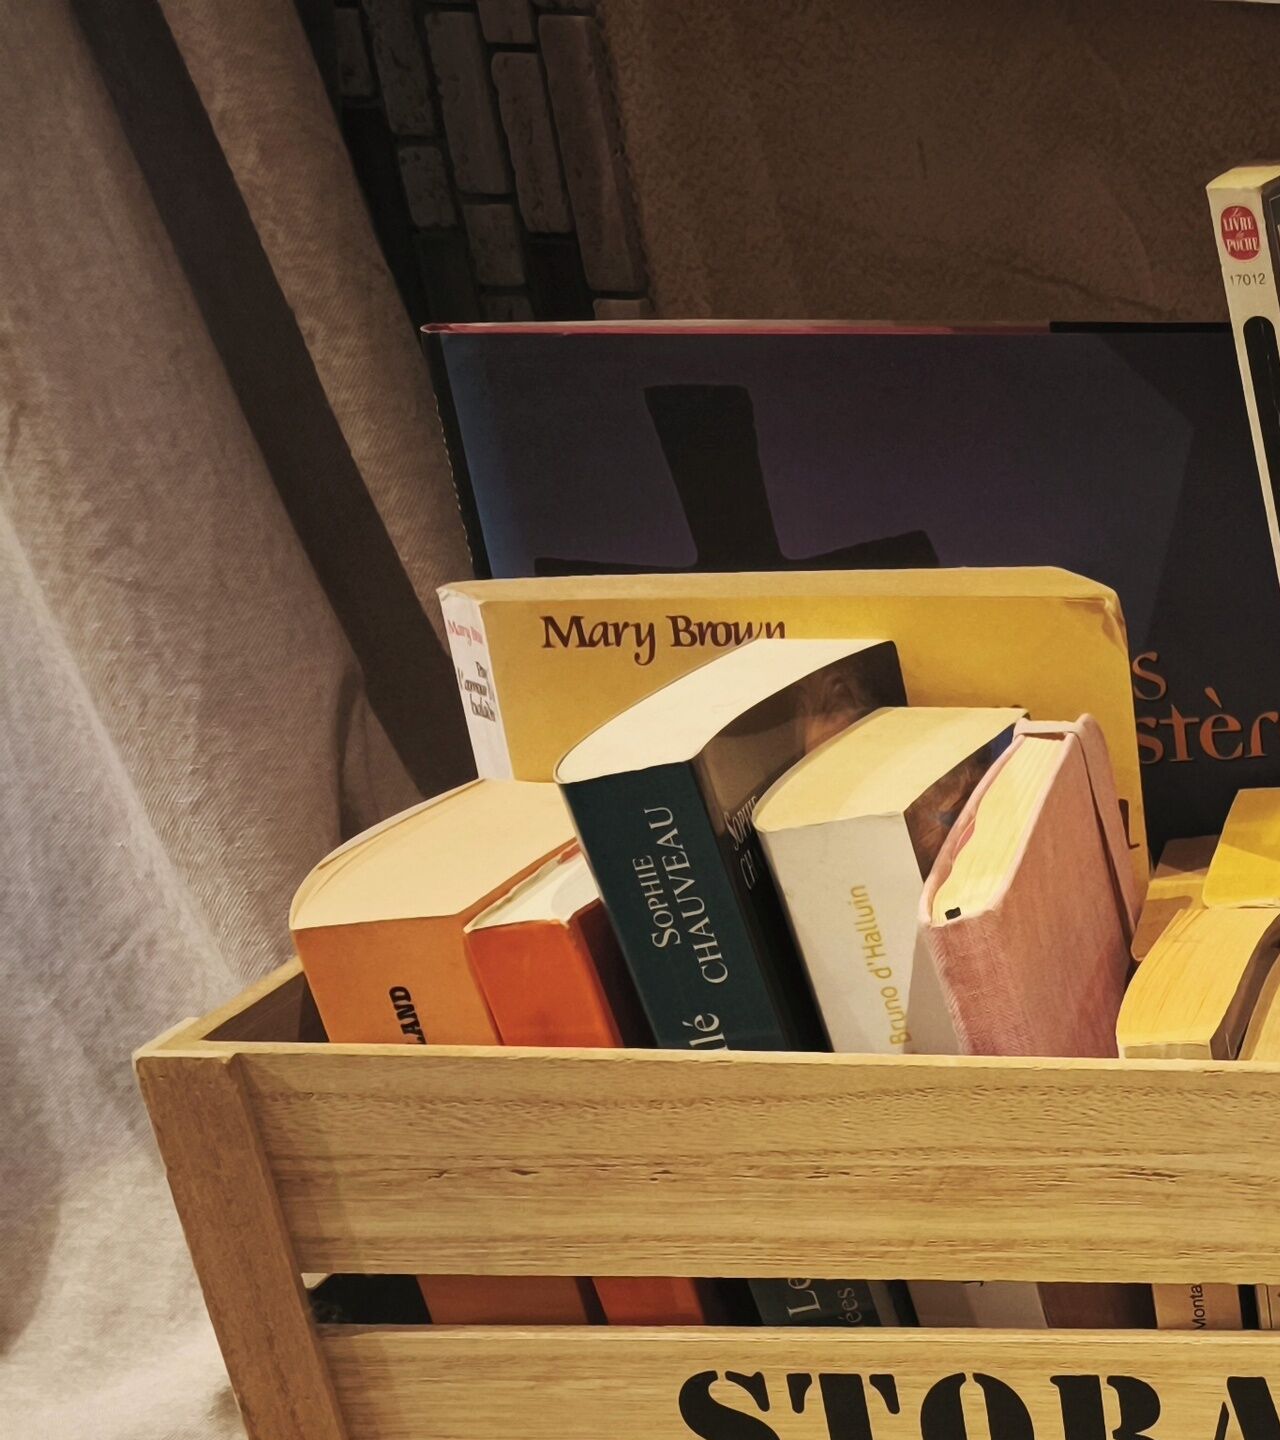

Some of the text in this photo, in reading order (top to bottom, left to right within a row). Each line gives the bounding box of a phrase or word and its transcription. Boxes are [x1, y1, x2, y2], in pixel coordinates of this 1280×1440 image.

[1230, 272, 1266, 286] 17012
[540, 615, 786, 666] Mary Brown
[632, 855, 681, 948] SOPHIE
[644, 805, 729, 985] CHAUVEAU
[849, 884, 912, 1046] Bruno d'Halluin
